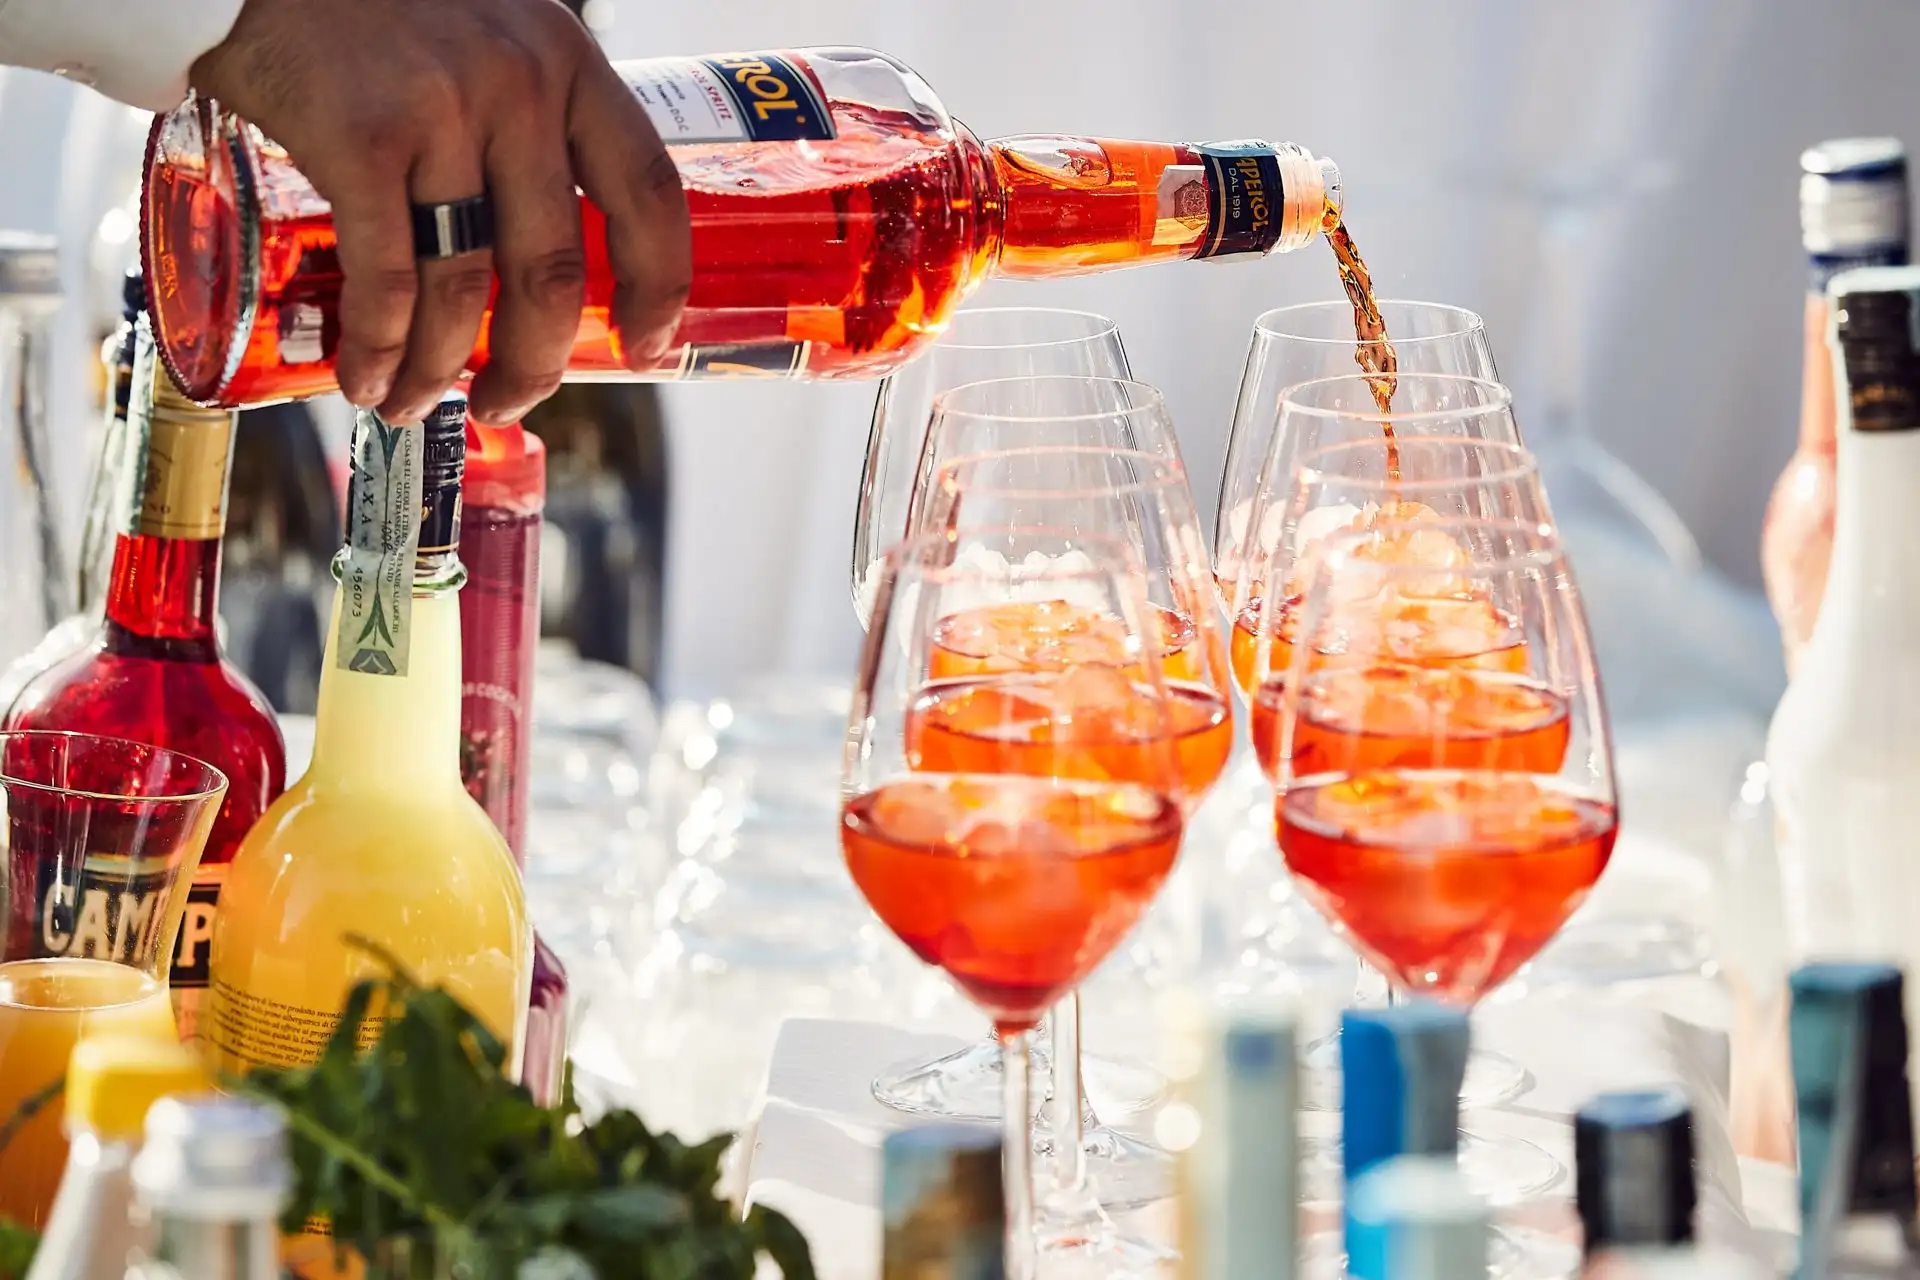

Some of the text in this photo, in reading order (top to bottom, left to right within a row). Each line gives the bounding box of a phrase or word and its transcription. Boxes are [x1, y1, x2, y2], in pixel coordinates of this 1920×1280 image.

[1228, 168, 1241, 219] DAL 1919
[1236, 158, 1269, 232] APEROL
[352, 568, 363, 618] 456073
